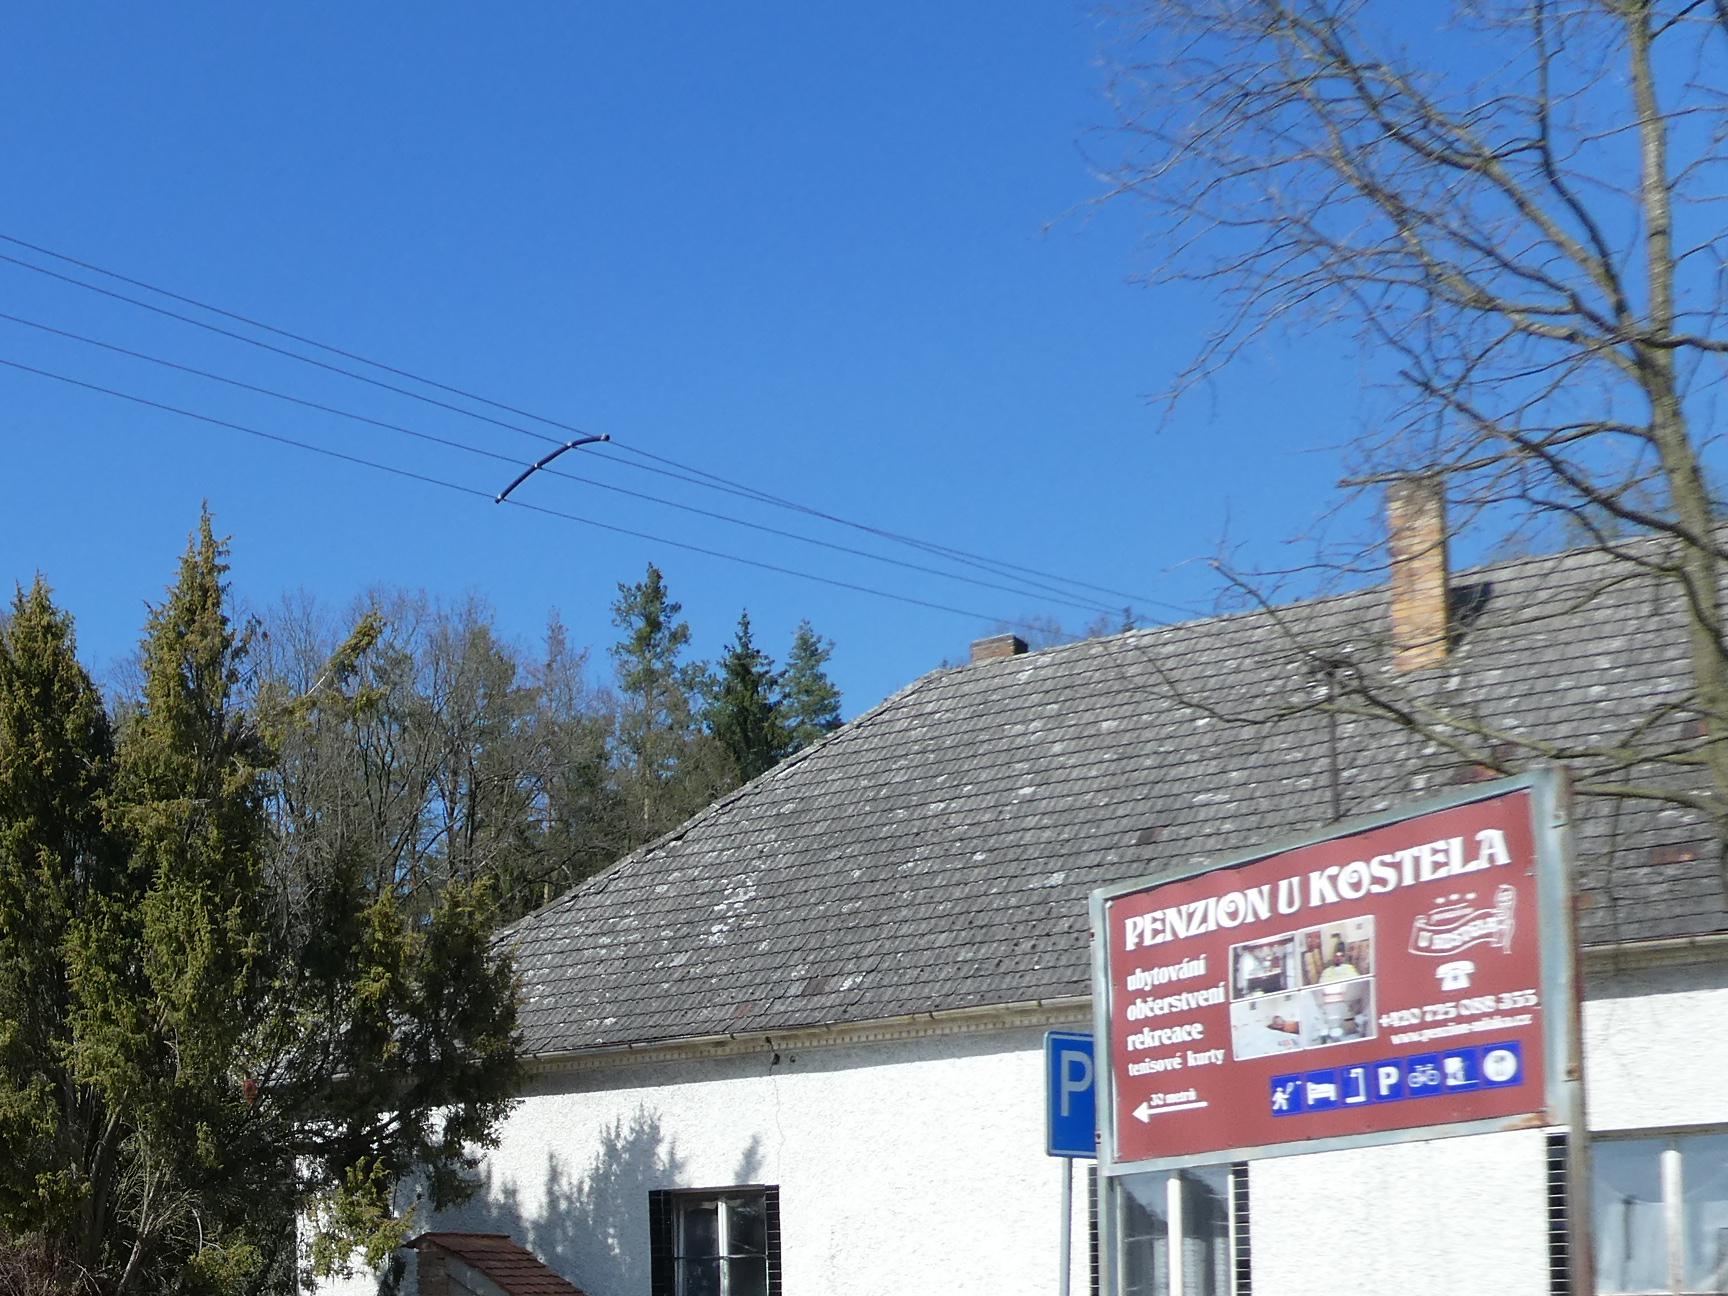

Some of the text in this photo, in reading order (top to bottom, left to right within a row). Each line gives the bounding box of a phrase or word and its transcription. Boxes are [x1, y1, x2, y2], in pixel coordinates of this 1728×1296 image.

[1124, 829, 1511, 950] PENZION U KOSTELA
[1126, 954, 1207, 991] ubytování
[1126, 981, 1226, 1020] občerstvení
[1127, 1023, 1204, 1051] rekreace
[1128, 1049, 1225, 1076] tenisové kurty
[1378, 1066, 1400, 1095] P
[1060, 1049, 1093, 1117] P
